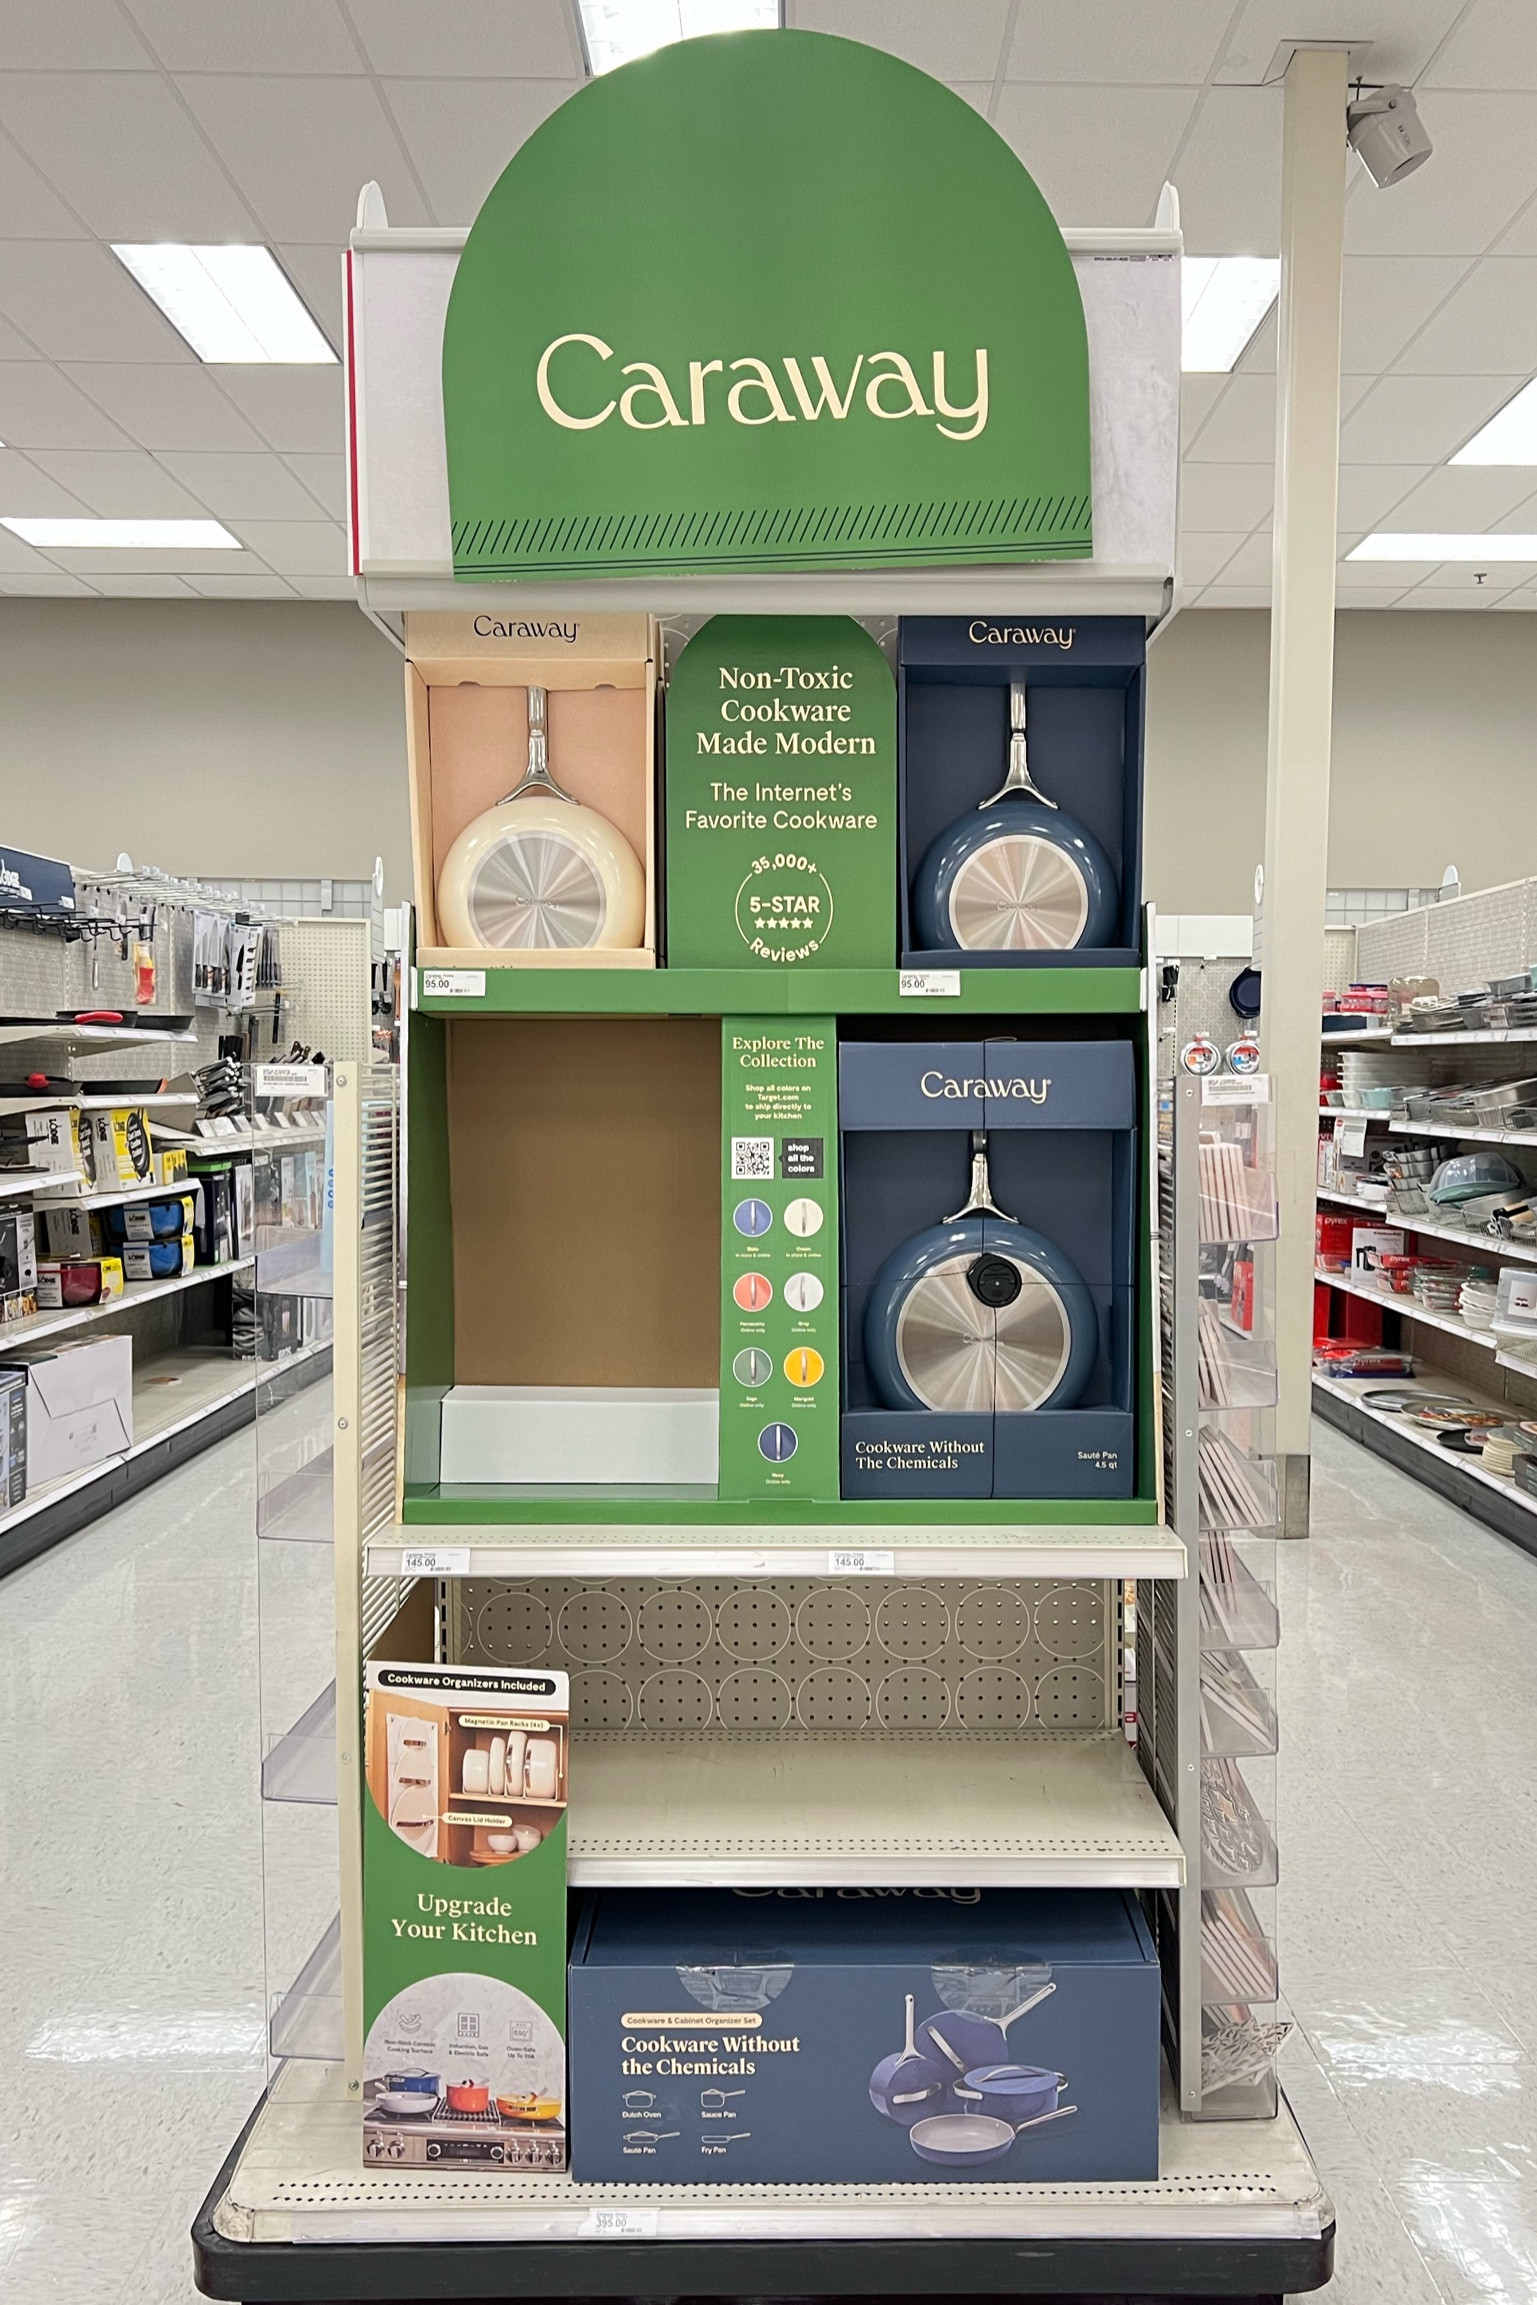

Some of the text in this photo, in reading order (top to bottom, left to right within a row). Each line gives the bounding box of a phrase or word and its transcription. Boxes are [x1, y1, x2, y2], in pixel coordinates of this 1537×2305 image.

[536, 333, 988, 441] Caraway
[473, 614, 577, 643] Caraway
[969, 620, 1072, 650] Caraway
[719, 665, 853, 690] Non-Toxic
[720, 698, 851, 722] Cookware
[696, 730, 876, 755] Made Modern
[710, 782, 852, 801] The Internet's
[685, 810, 878, 829] Favorite Cookware
[751, 853, 817, 874] 35,000+
[750, 896, 820, 913] 5-STAR
[750, 937, 819, 962] Reviews
[425, 979, 449, 989] 95.00
[901, 979, 925, 989] 95.00
[732, 1036, 825, 1053] Explore The
[740, 1053, 817, 1068] Collection
[745, 1084, 764, 1093] Shop
[766, 1084, 775, 1092] all
[776, 1084, 800, 1092] colors
[921, 1071, 1047, 1104] Caraway
[757, 1093, 799, 1103] Target.com
[755, 1103, 771, 1111] ship
[772, 1103, 802, 1111] directly
[755, 1112, 803, 1121] your kitchen
[787, 1143, 809, 1153] shop
[787, 1154, 815, 1162] all the
[787, 1164, 815, 1173] colors
[855, 1440, 985, 1453] Cookware Without
[1077, 1451, 1118, 1459] Sauté Pan
[855, 1456, 959, 1469] The Chemicals
[1095, 1461, 1118, 1470] 4.5 qt
[406, 1558, 436, 1567] 145.00
[835, 1558, 865, 1567] 145.00
[387, 1673, 546, 1692] Cookware Organizers Included
[464, 1718, 495, 1727] Magnetic
[496, 1719, 509, 1727] Pan
[510, 1720, 530, 1728] Racks
[448, 1815, 472, 1823] Canvas
[484, 1817, 506, 1825] Holder
[417, 1893, 512, 1918] Upgrade
[391, 1919, 538, 1946] Your Kitchen
[627, 2016, 756, 2026] Cookware & Cabinet Organizer Set
[621, 2035, 800, 2053] Cookware Without
[621, 2057, 756, 2075] the Chemicals
[622, 2111, 662, 2119] Dutch Oven
[701, 2111, 722, 2119] Sauce
[643, 2146, 656, 2154] Pan
[701, 2146, 727, 2155] Fry Pan
[596, 2219, 627, 2228] 395.00
